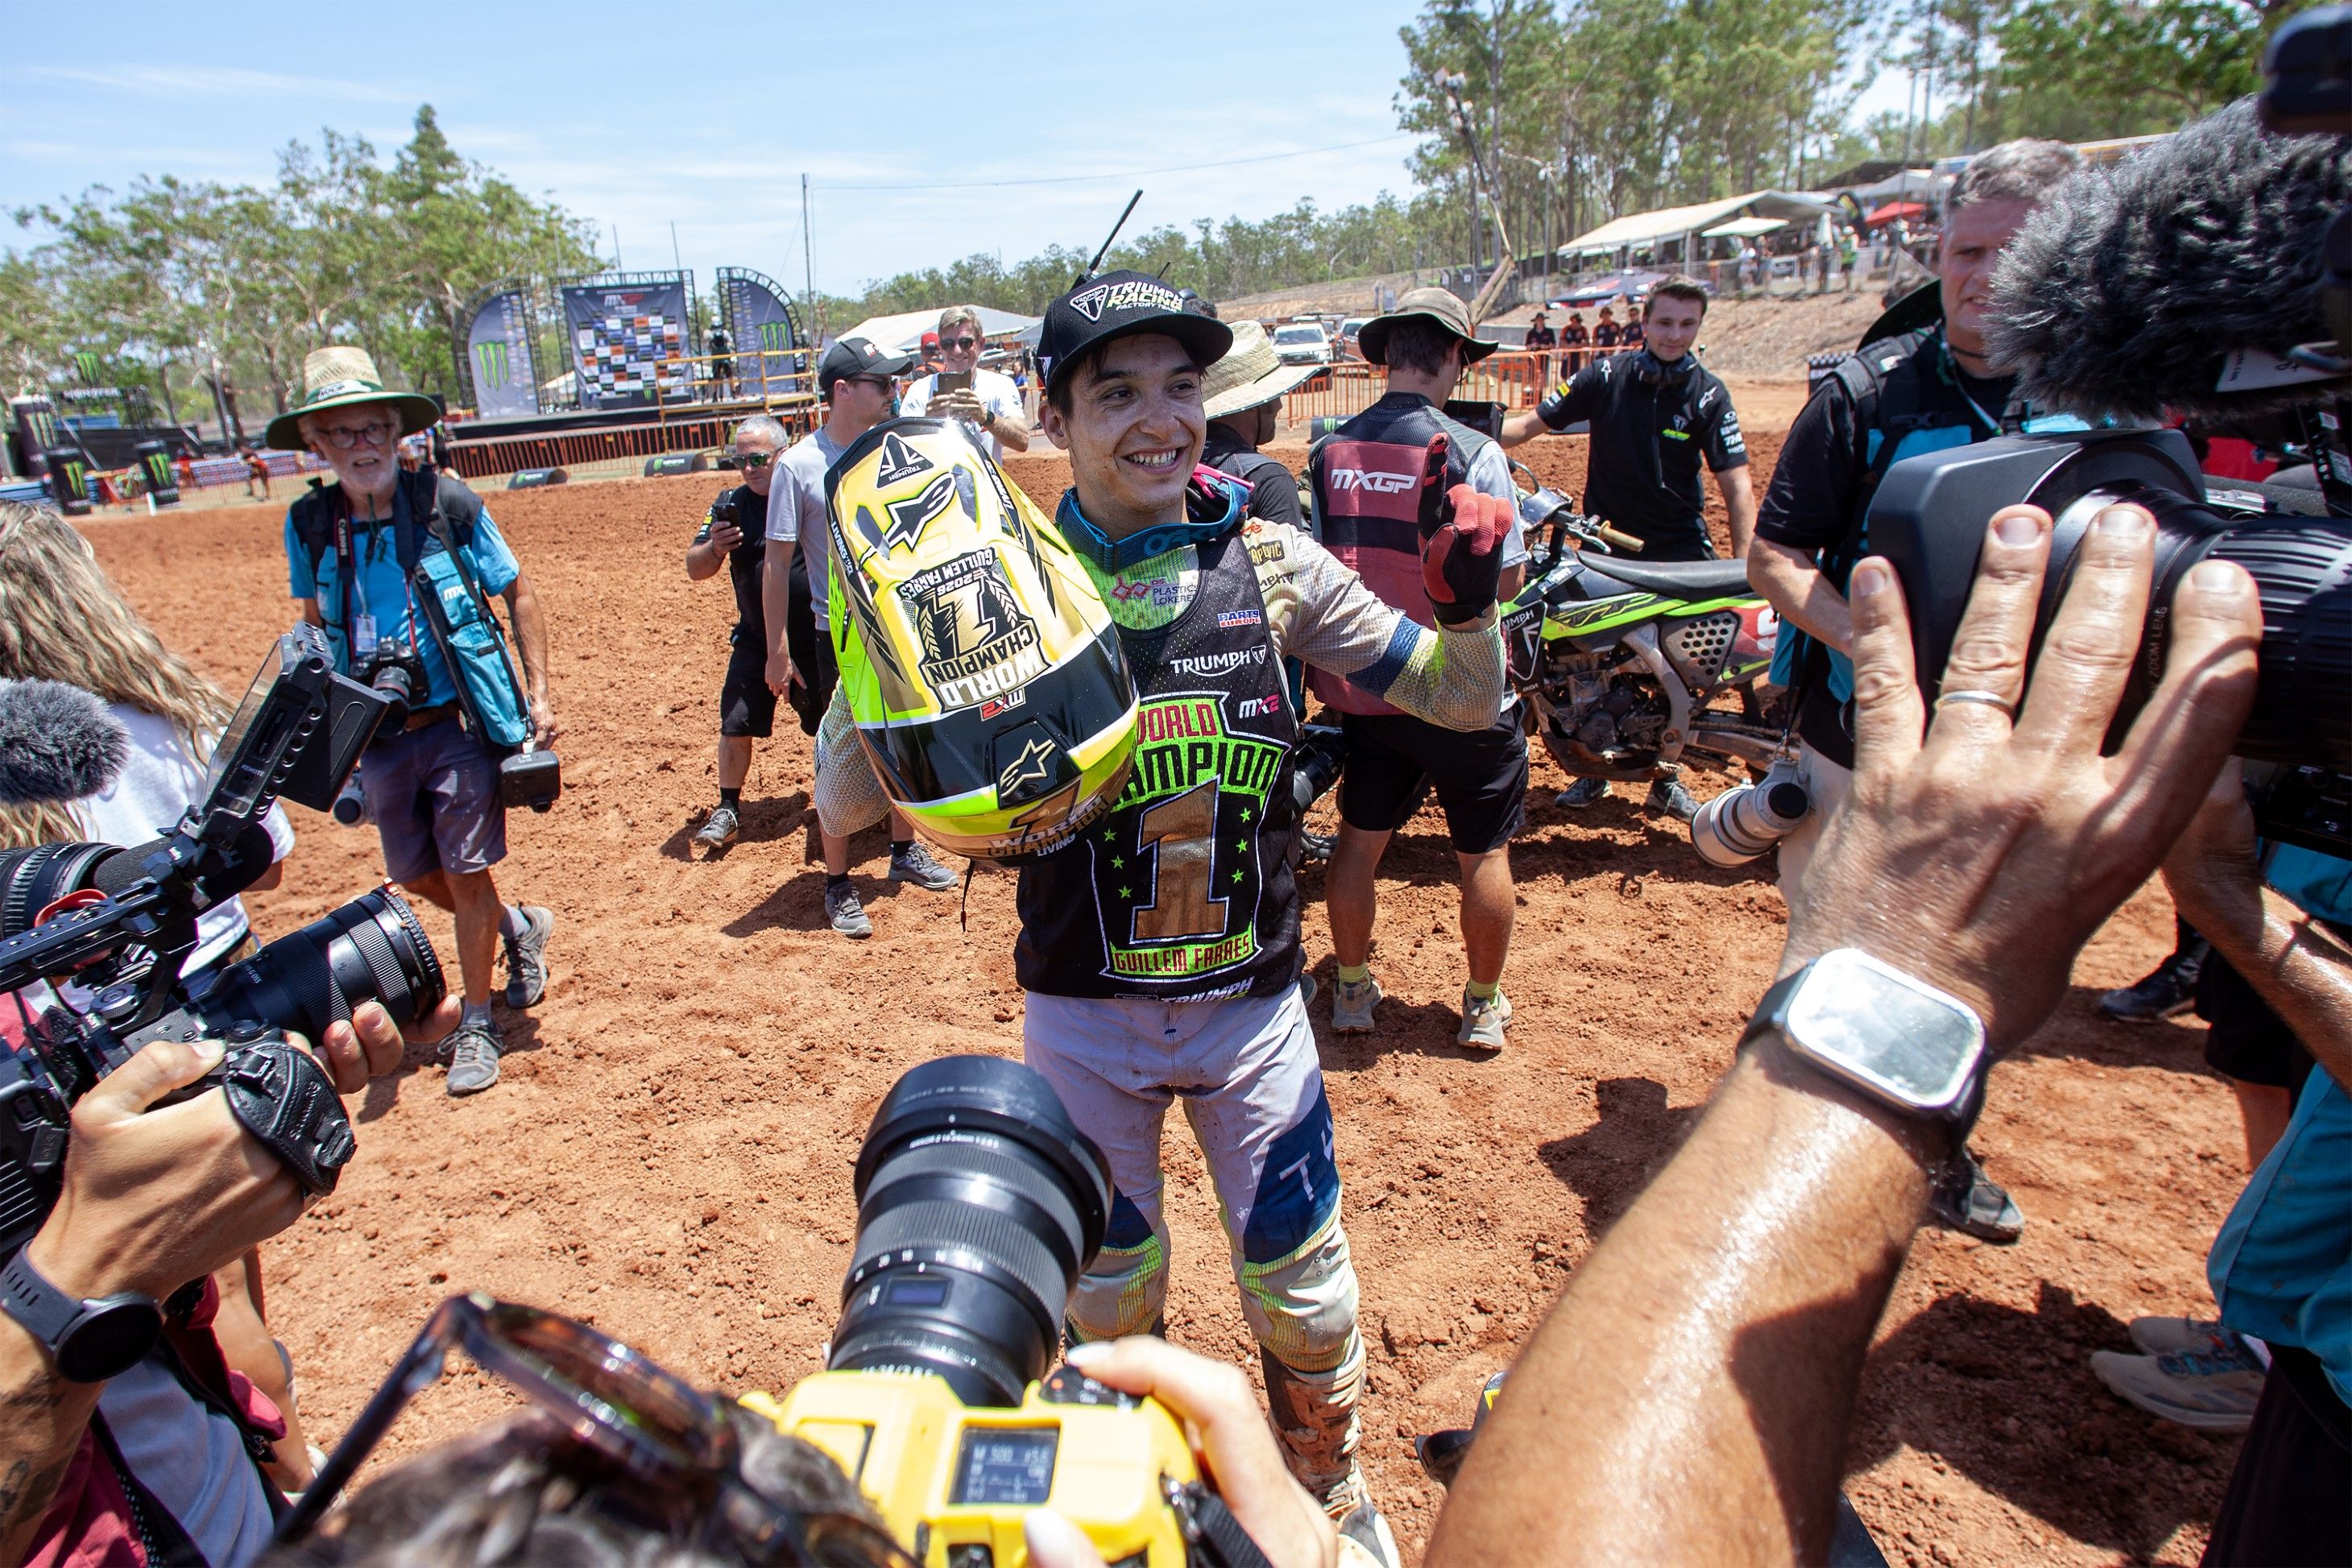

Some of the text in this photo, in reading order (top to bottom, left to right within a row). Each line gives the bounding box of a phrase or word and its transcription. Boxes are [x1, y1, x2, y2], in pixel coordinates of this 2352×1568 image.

[1075, 288, 1104, 304] TRIUMPH
[1106, 292, 1182, 312] RACING
[1109, 281, 1183, 303] TRIUMPH
[1116, 302, 1178, 313] FACTORY TEAM
[888, 465, 921, 482] TRIUMPH
[1331, 469, 1418, 495] MXGP
[831, 520, 848, 559] LIVING
[941, 548, 993, 580] GUILLEM
[937, 573, 975, 596] 2026
[1218, 610, 1260, 621] PARTS
[1219, 618, 1261, 627] EUROPE
[1501, 610, 1534, 628] UMPH
[926, 625, 1034, 684] CHAMPION
[1170, 651, 1250, 676] TRIUMPH
[2149, 643, 2159, 677] ZOOM
[938, 647, 1044, 707] WORLD
[981, 690, 1025, 720] MX2
[1239, 693, 1280, 719] MX2
[241, 764, 265, 777] REMOTE
[1037, 833, 1076, 857] LIVING
[1133, 777, 1228, 942] 1
[1115, 934, 1249, 972] GUILLEM FARRES
